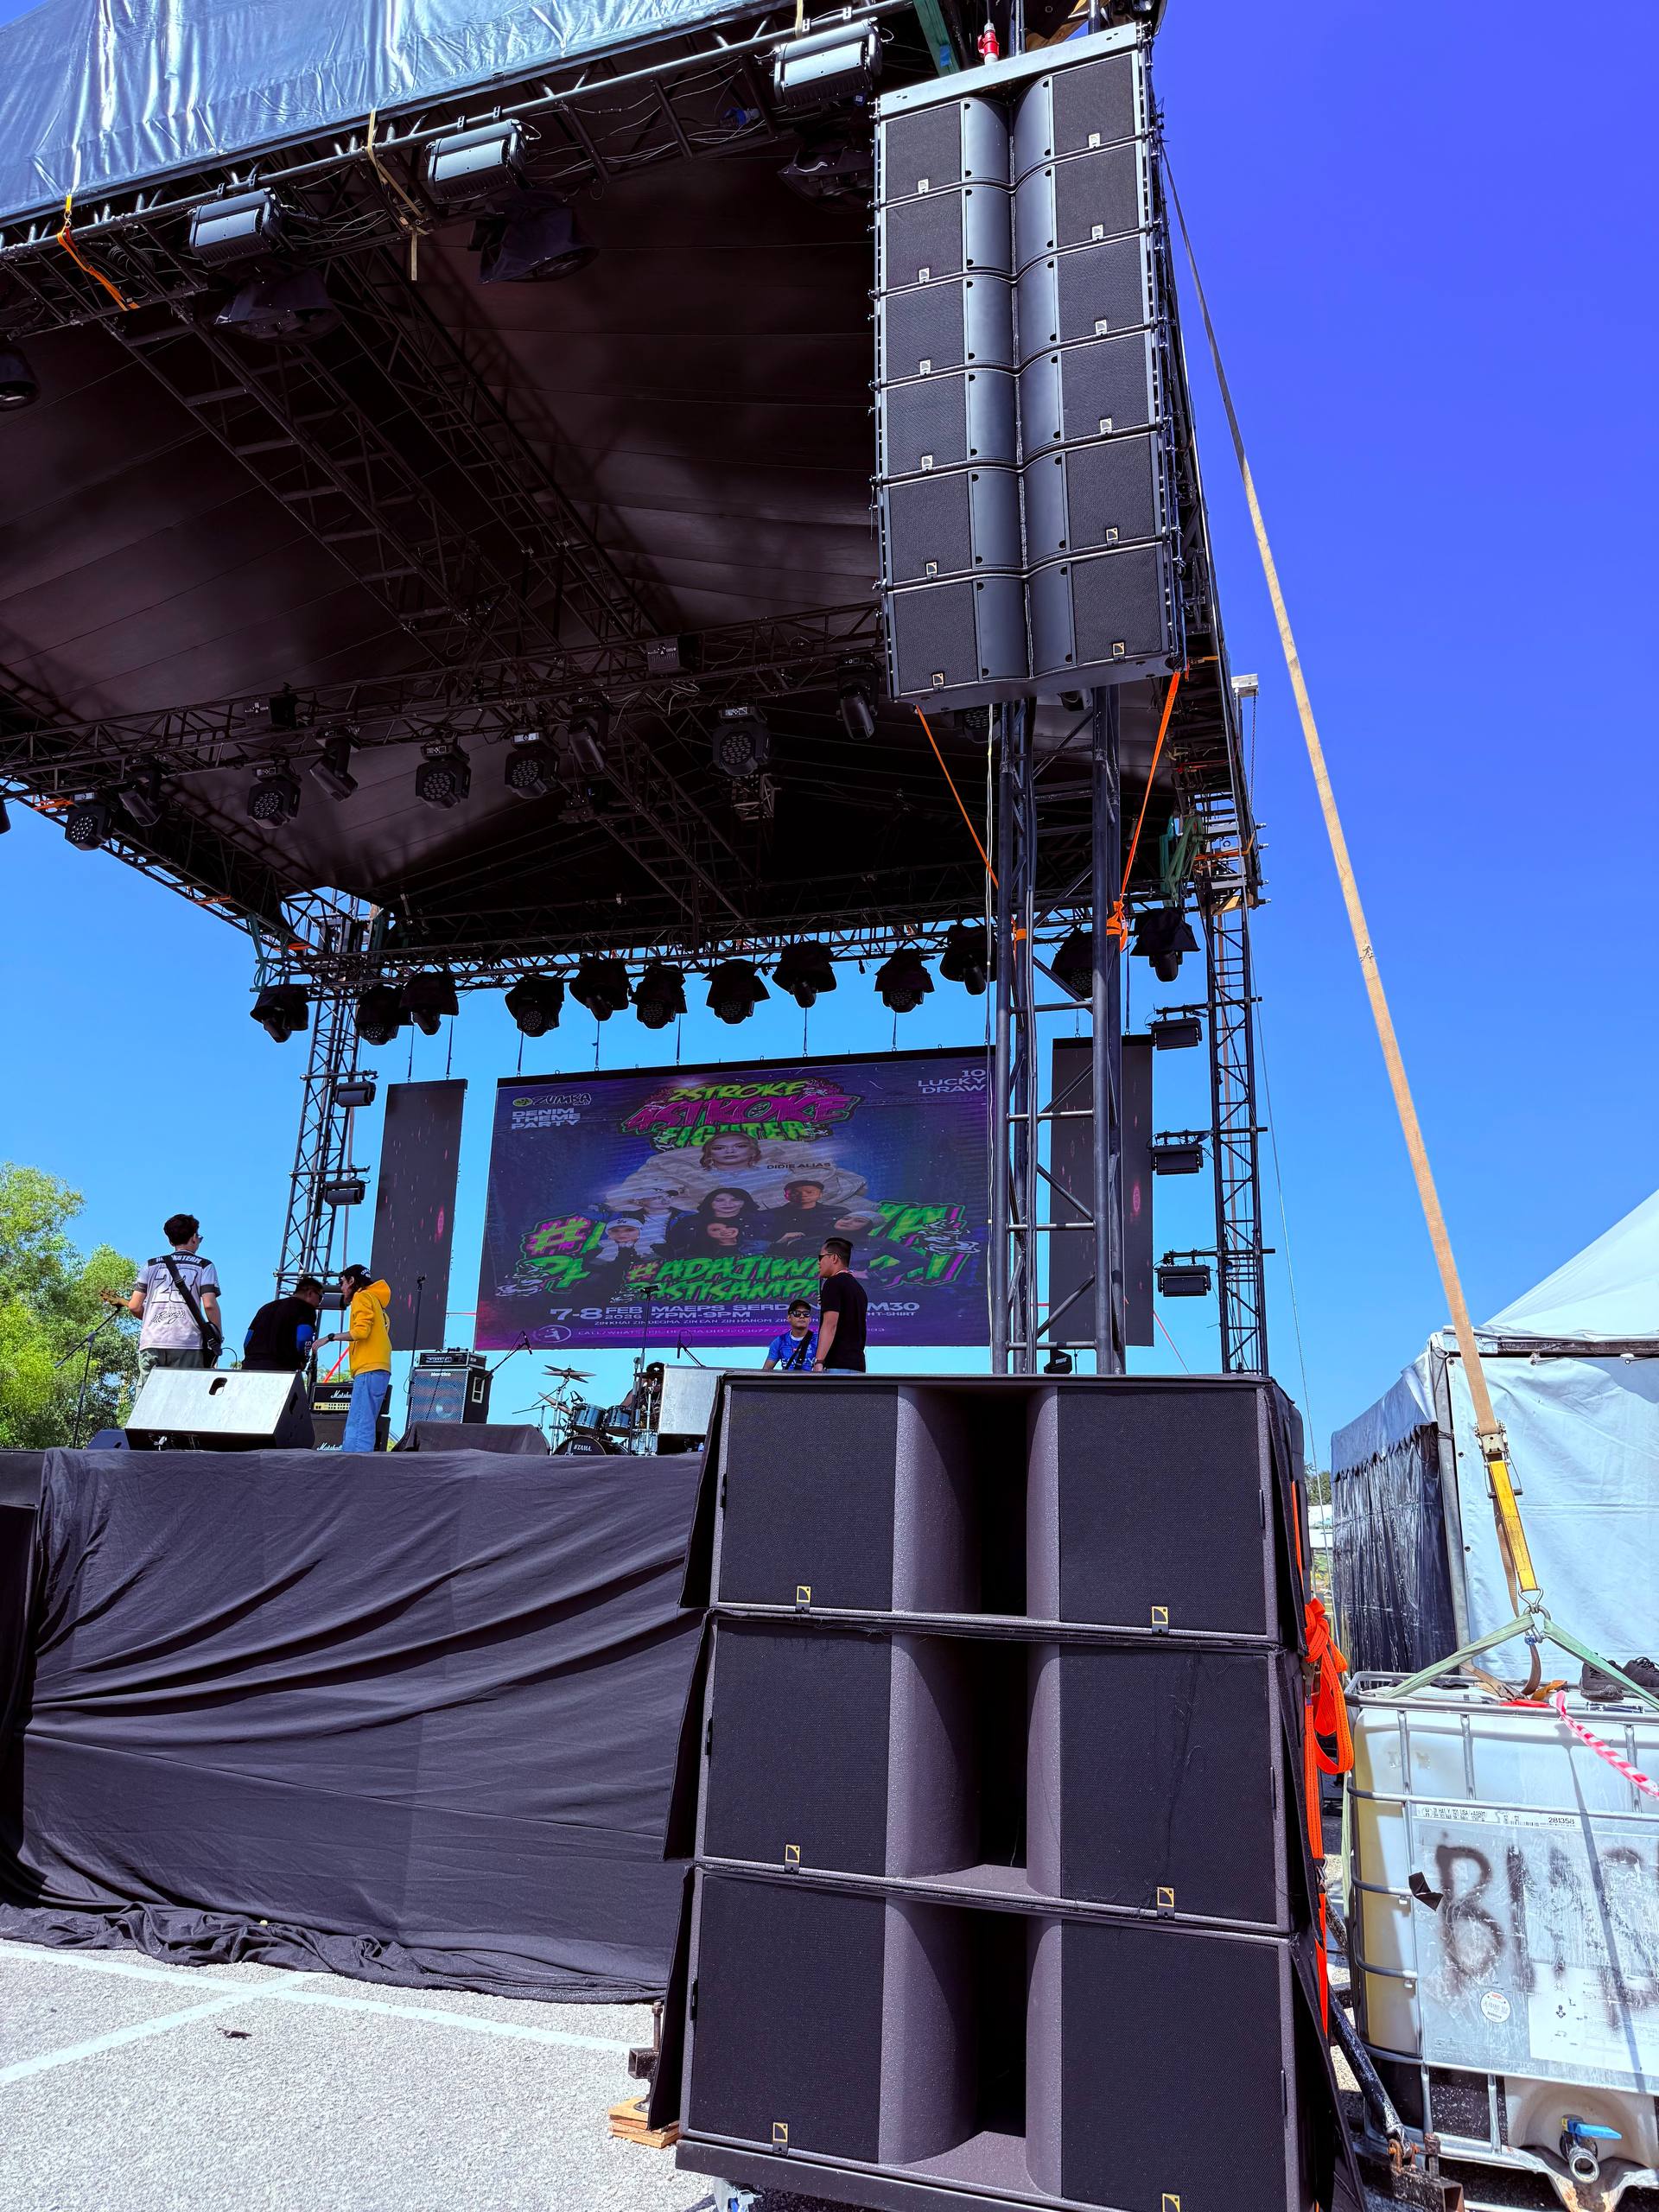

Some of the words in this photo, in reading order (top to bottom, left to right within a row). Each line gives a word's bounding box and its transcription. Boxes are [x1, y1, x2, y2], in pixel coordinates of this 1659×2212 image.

[961, 1069, 986, 1077] 10
[918, 1077, 987, 1087] LUCKY
[667, 1081, 807, 1103] 2STROKE
[922, 1084, 987, 1094] DRAW
[531, 1092, 592, 1106] ZUMBA
[512, 1108, 575, 1117] DENIM
[512, 1113, 581, 1122] THEME
[622, 1095, 858, 1133] 4STROKE
[511, 1119, 580, 1129] PARTY
[867, 1302, 920, 1311] M30
[550, 1307, 603, 1321] 7-8
[651, 1311, 751, 1319] 7PM-9PM
[330, 1389, 353, 1399] Marsha
